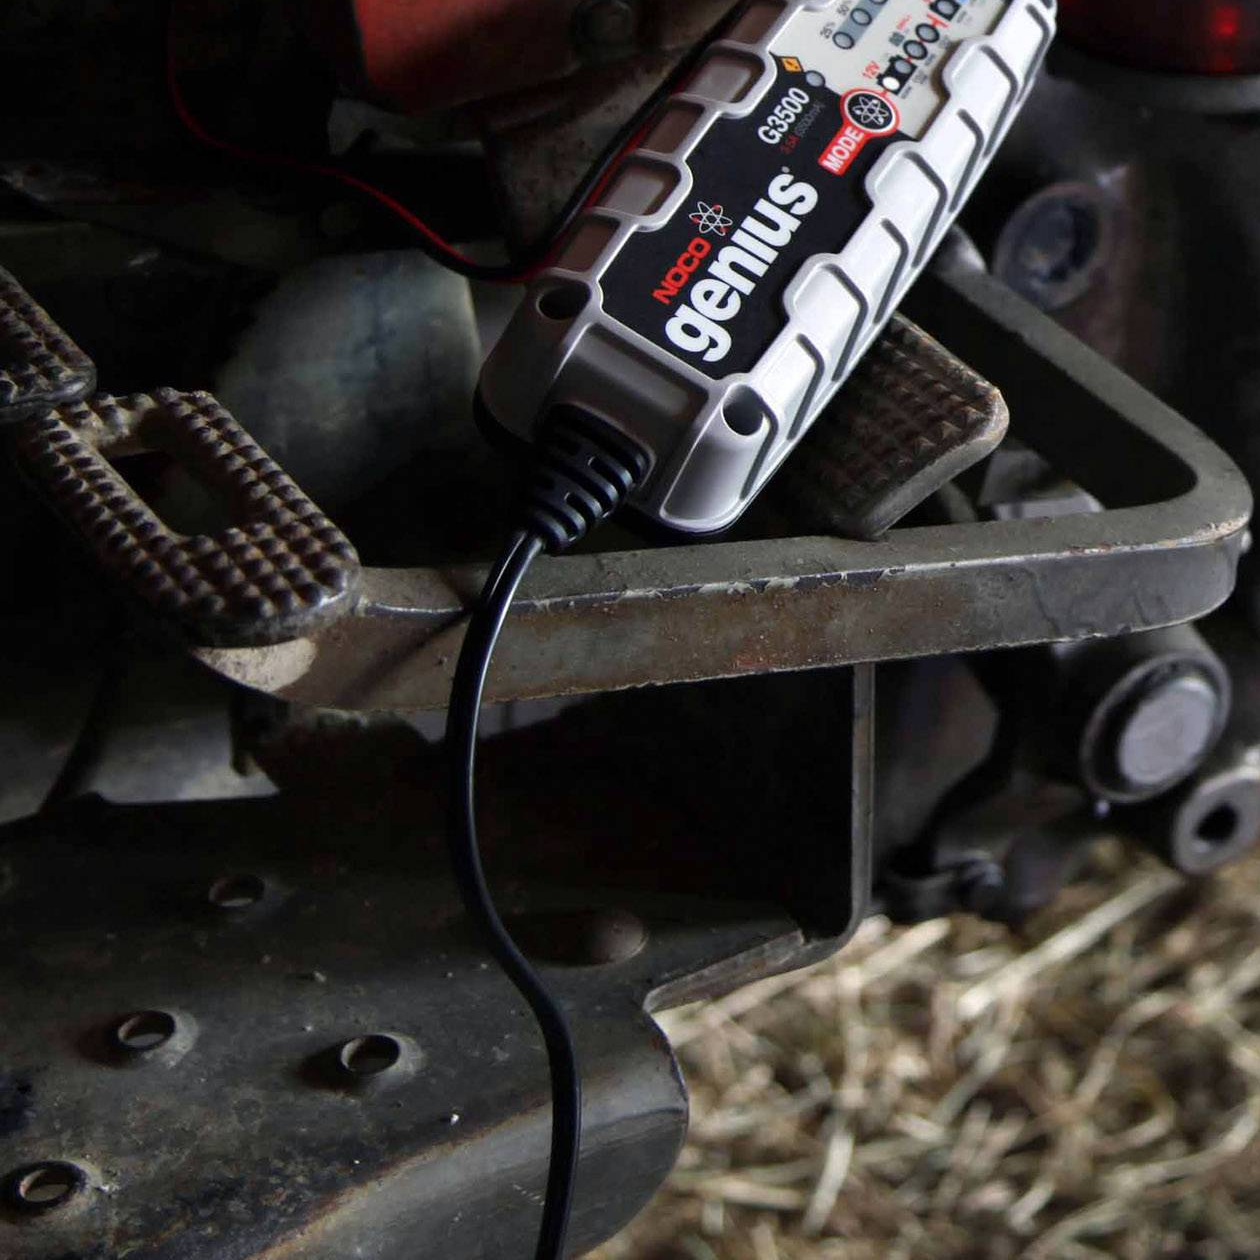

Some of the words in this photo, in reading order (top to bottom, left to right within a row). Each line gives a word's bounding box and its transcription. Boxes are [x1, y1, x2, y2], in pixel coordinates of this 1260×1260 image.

[757, 87, 810, 145] G3500
[822, 126, 865, 172] MODE
[651, 236, 712, 305] NOCO
[664, 171, 819, 363] genius
